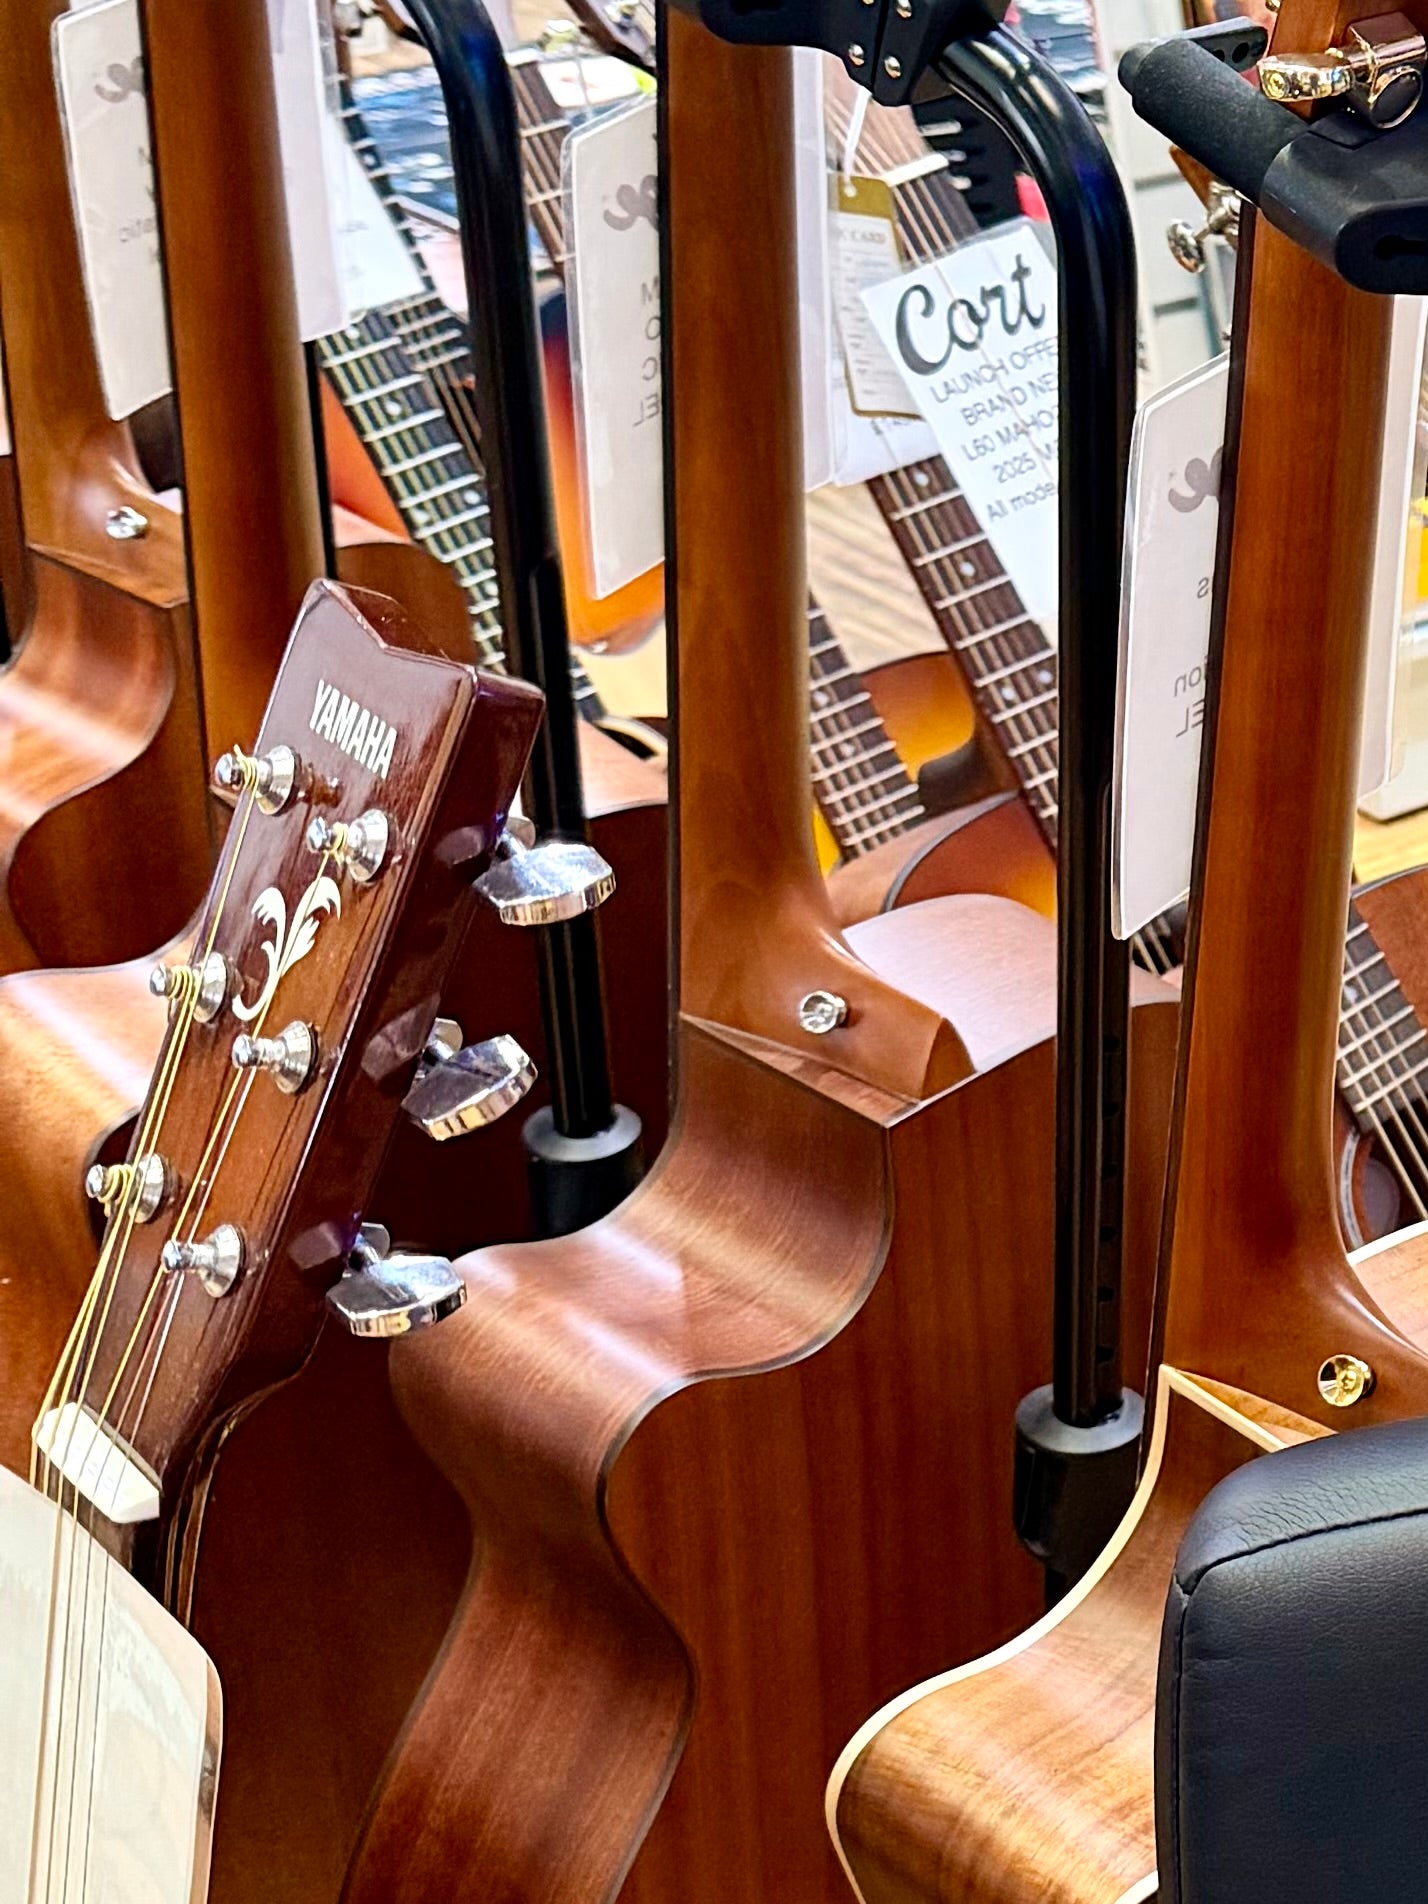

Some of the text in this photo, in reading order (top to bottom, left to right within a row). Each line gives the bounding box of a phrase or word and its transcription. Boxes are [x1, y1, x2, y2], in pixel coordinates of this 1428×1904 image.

[896, 252, 1047, 377] Cort
[929, 335, 1058, 404] LAUNCH OFFE
[960, 370, 1058, 427] BRAND NE
[961, 405, 1059, 462] L60 MAHO
[992, 451, 1038, 485] 2025
[986, 481, 1057, 523] All mode
[307, 678, 398, 781] YAMAHA
